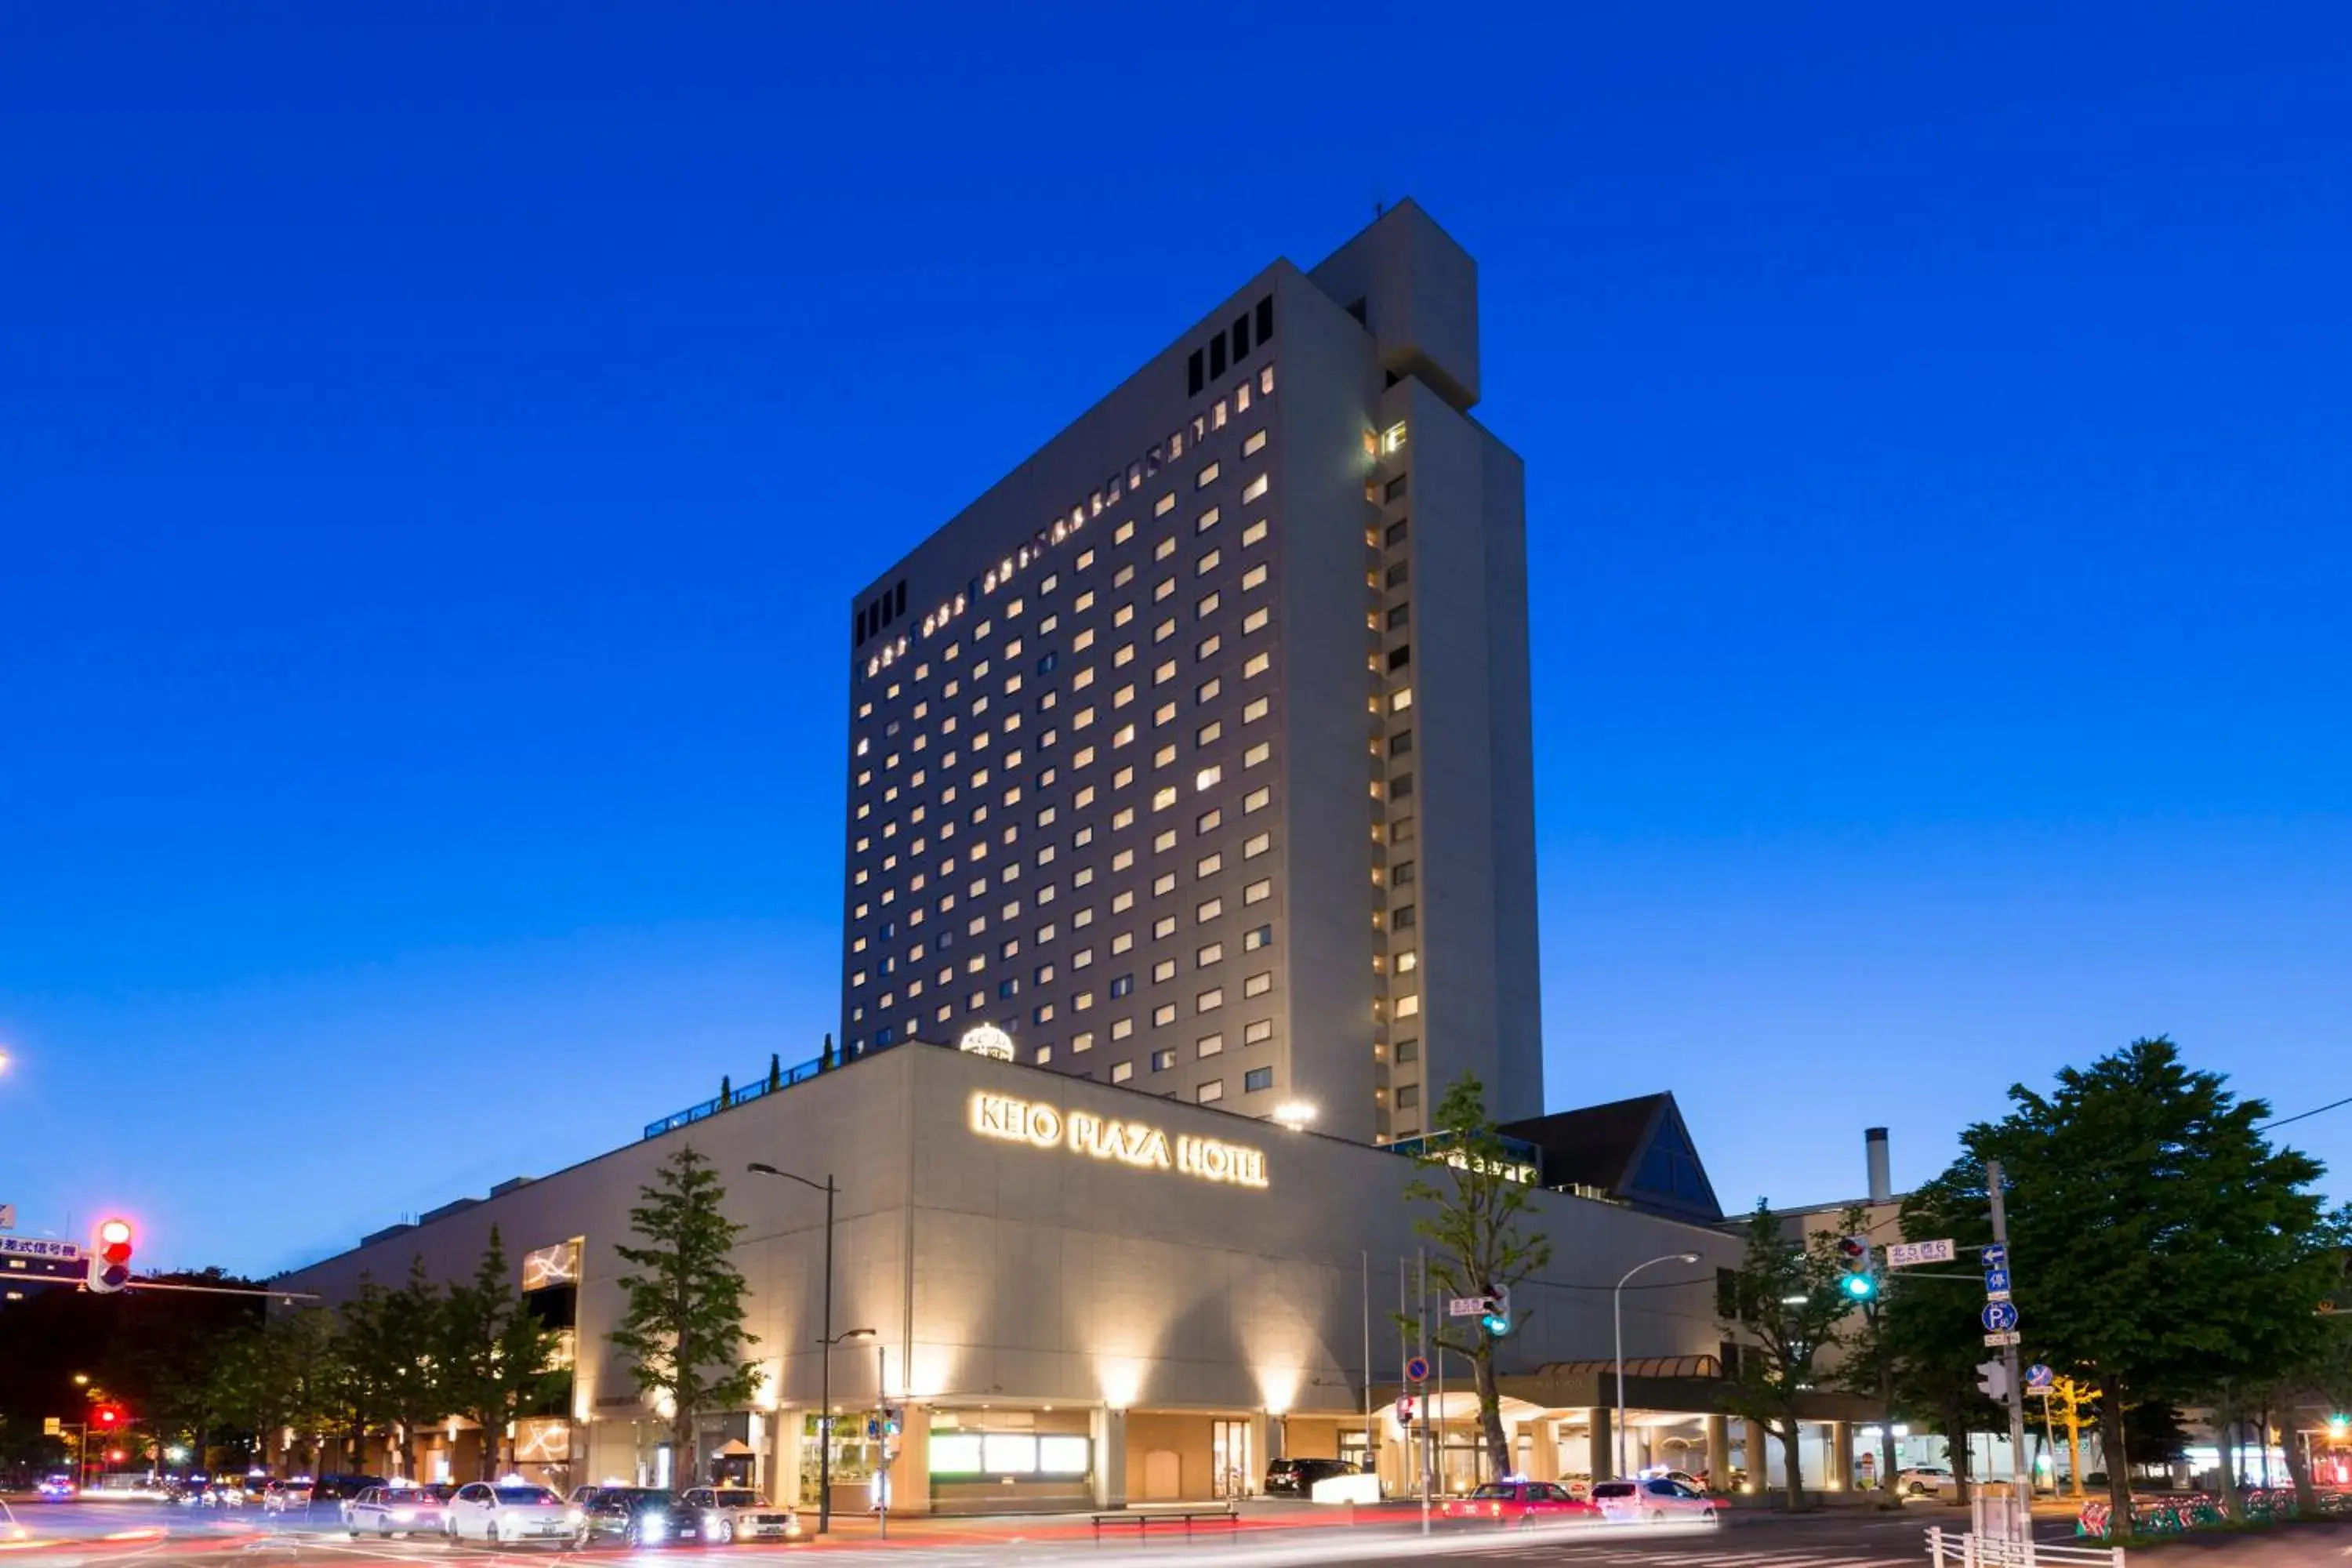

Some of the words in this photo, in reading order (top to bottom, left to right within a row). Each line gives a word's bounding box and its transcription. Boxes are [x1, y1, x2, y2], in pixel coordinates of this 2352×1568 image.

[975, 1093, 1061, 1147] KEIO
[1069, 1113, 1171, 1171] PLAZA
[1178, 1136, 1269, 1189] HOTEL
[0, 1239, 77, 1257] 差式信号機
